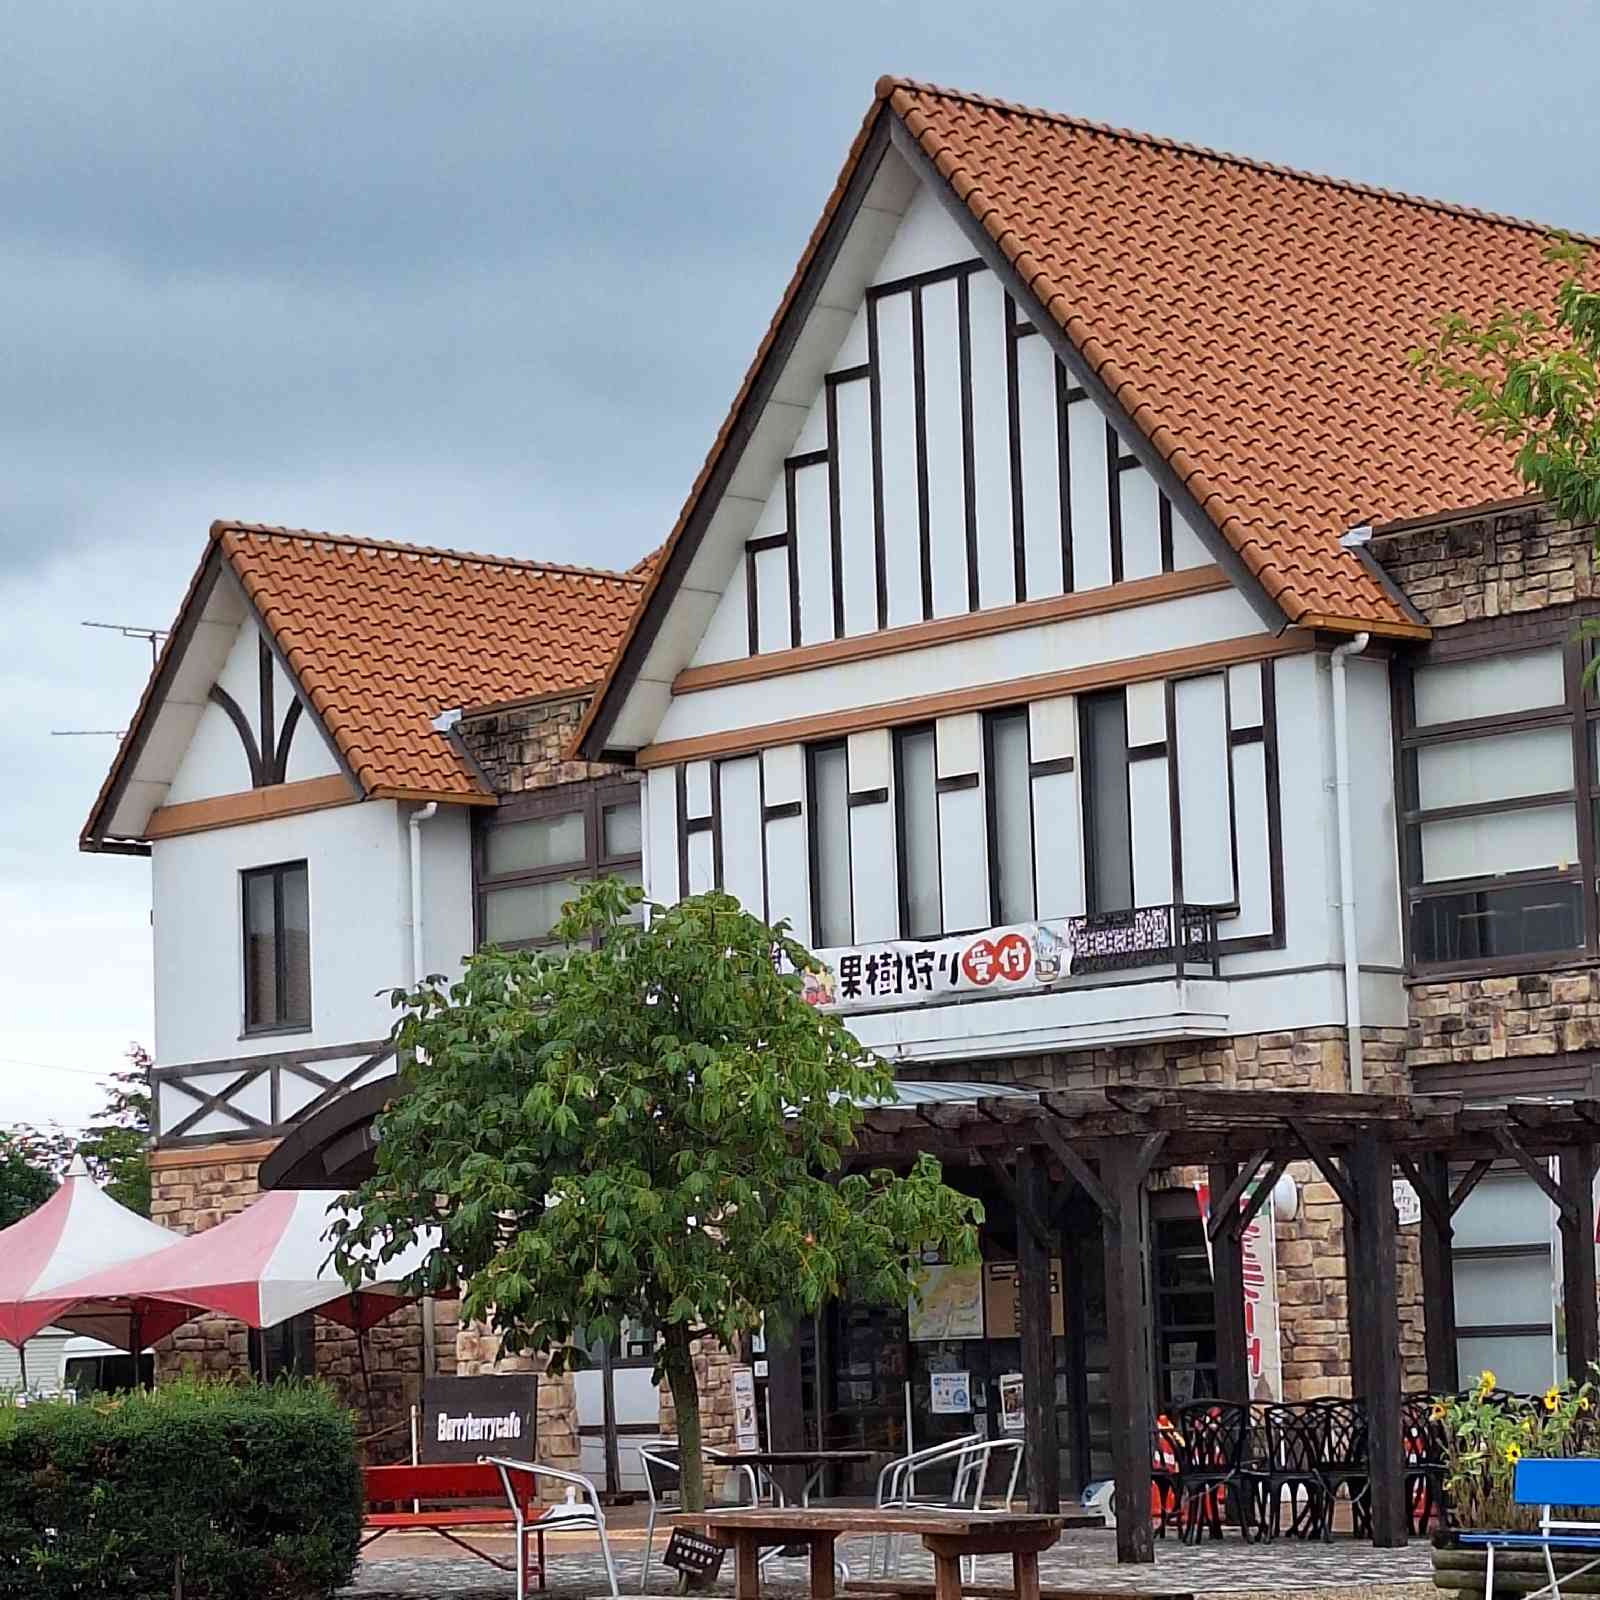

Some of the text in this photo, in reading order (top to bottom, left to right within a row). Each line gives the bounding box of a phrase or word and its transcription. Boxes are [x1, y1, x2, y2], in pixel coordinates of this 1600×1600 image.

[839, 941, 1027, 1000] 果樹狩り受付
